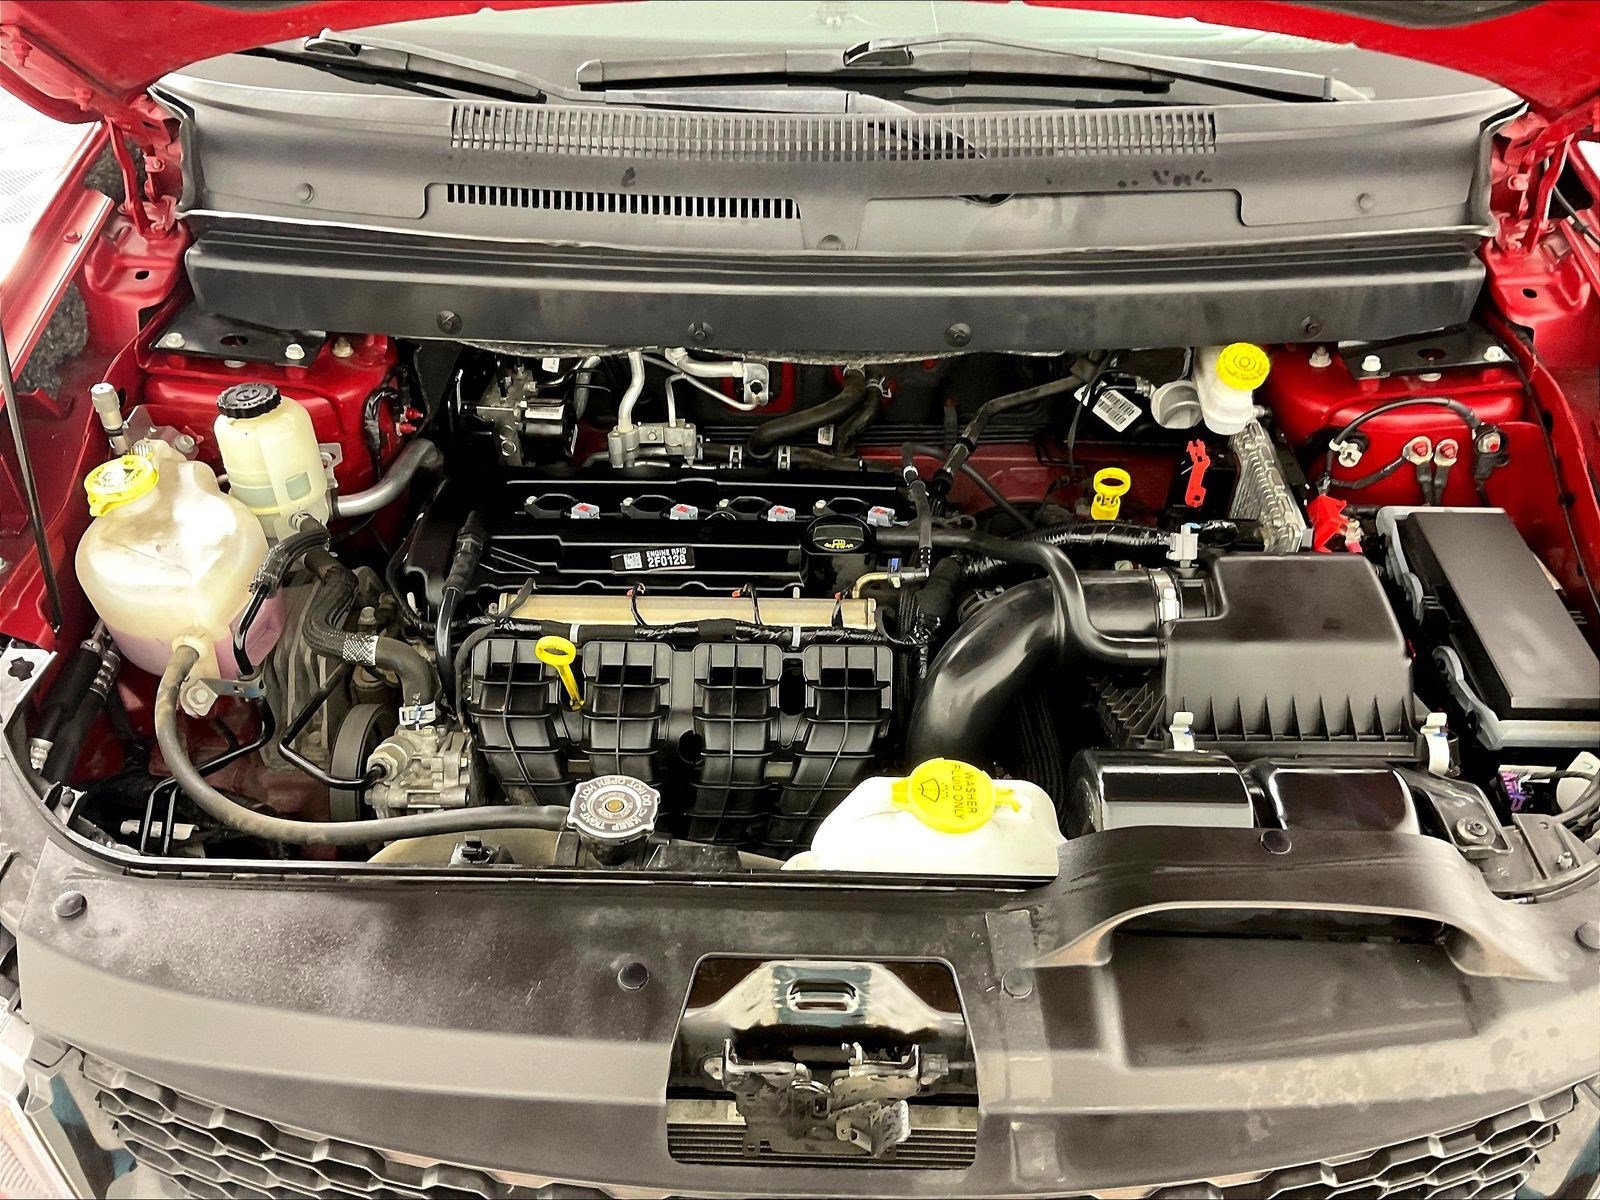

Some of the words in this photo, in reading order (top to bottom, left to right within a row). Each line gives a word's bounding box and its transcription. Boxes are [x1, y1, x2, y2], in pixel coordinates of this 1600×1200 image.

[646, 549, 670, 558] ENGINE
[951, 764, 963, 792] FLUID
[579, 784, 597, 801] HOT
[627, 781, 647, 794] NOT
[965, 772, 978, 813] WASHER
[642, 794, 652, 806] DO
[953, 796, 965, 820] ONLY
[579, 812, 606, 830] TIGHT
